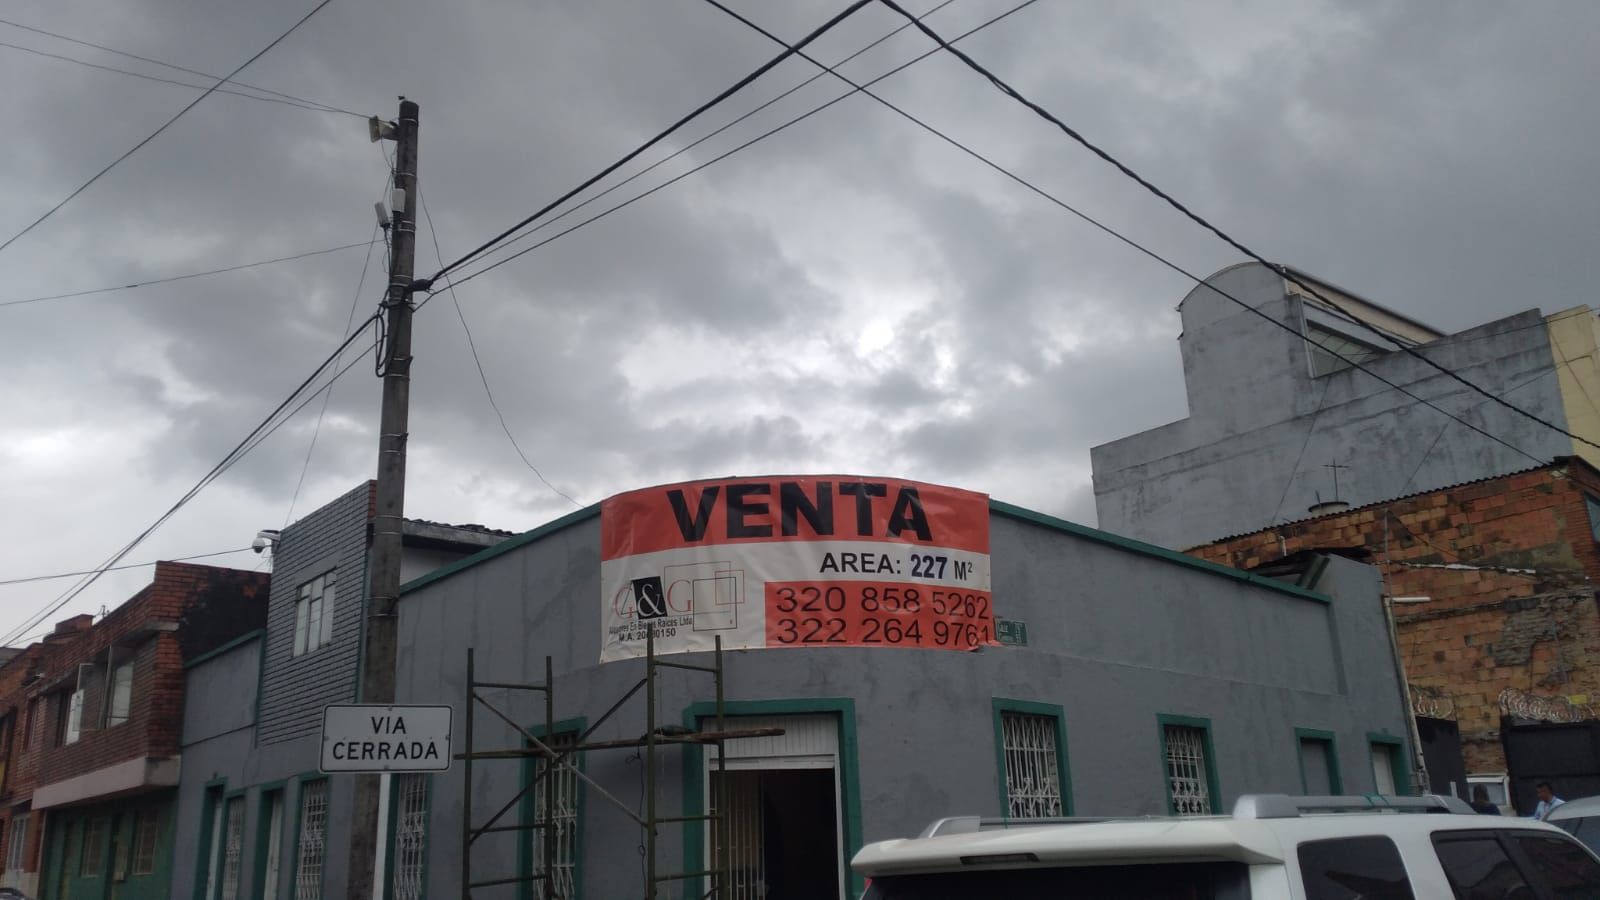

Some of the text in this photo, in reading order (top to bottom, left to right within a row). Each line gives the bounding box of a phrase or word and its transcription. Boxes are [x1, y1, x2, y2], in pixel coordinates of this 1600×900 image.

[666, 481, 933, 543] VENTA
[819, 552, 901, 575] AREA:
[910, 554, 948, 579] 227
[776, 587, 989, 620] 320 858 5262
[636, 628, 677, 640] 2080150
[638, 620, 656, 630] Biees
[777, 618, 847, 644] 322
[861, 618, 923, 643] 264
[933, 621, 990, 647] 9761
[371, 716, 406, 734] VIA
[332, 741, 439, 760] CERRADA
